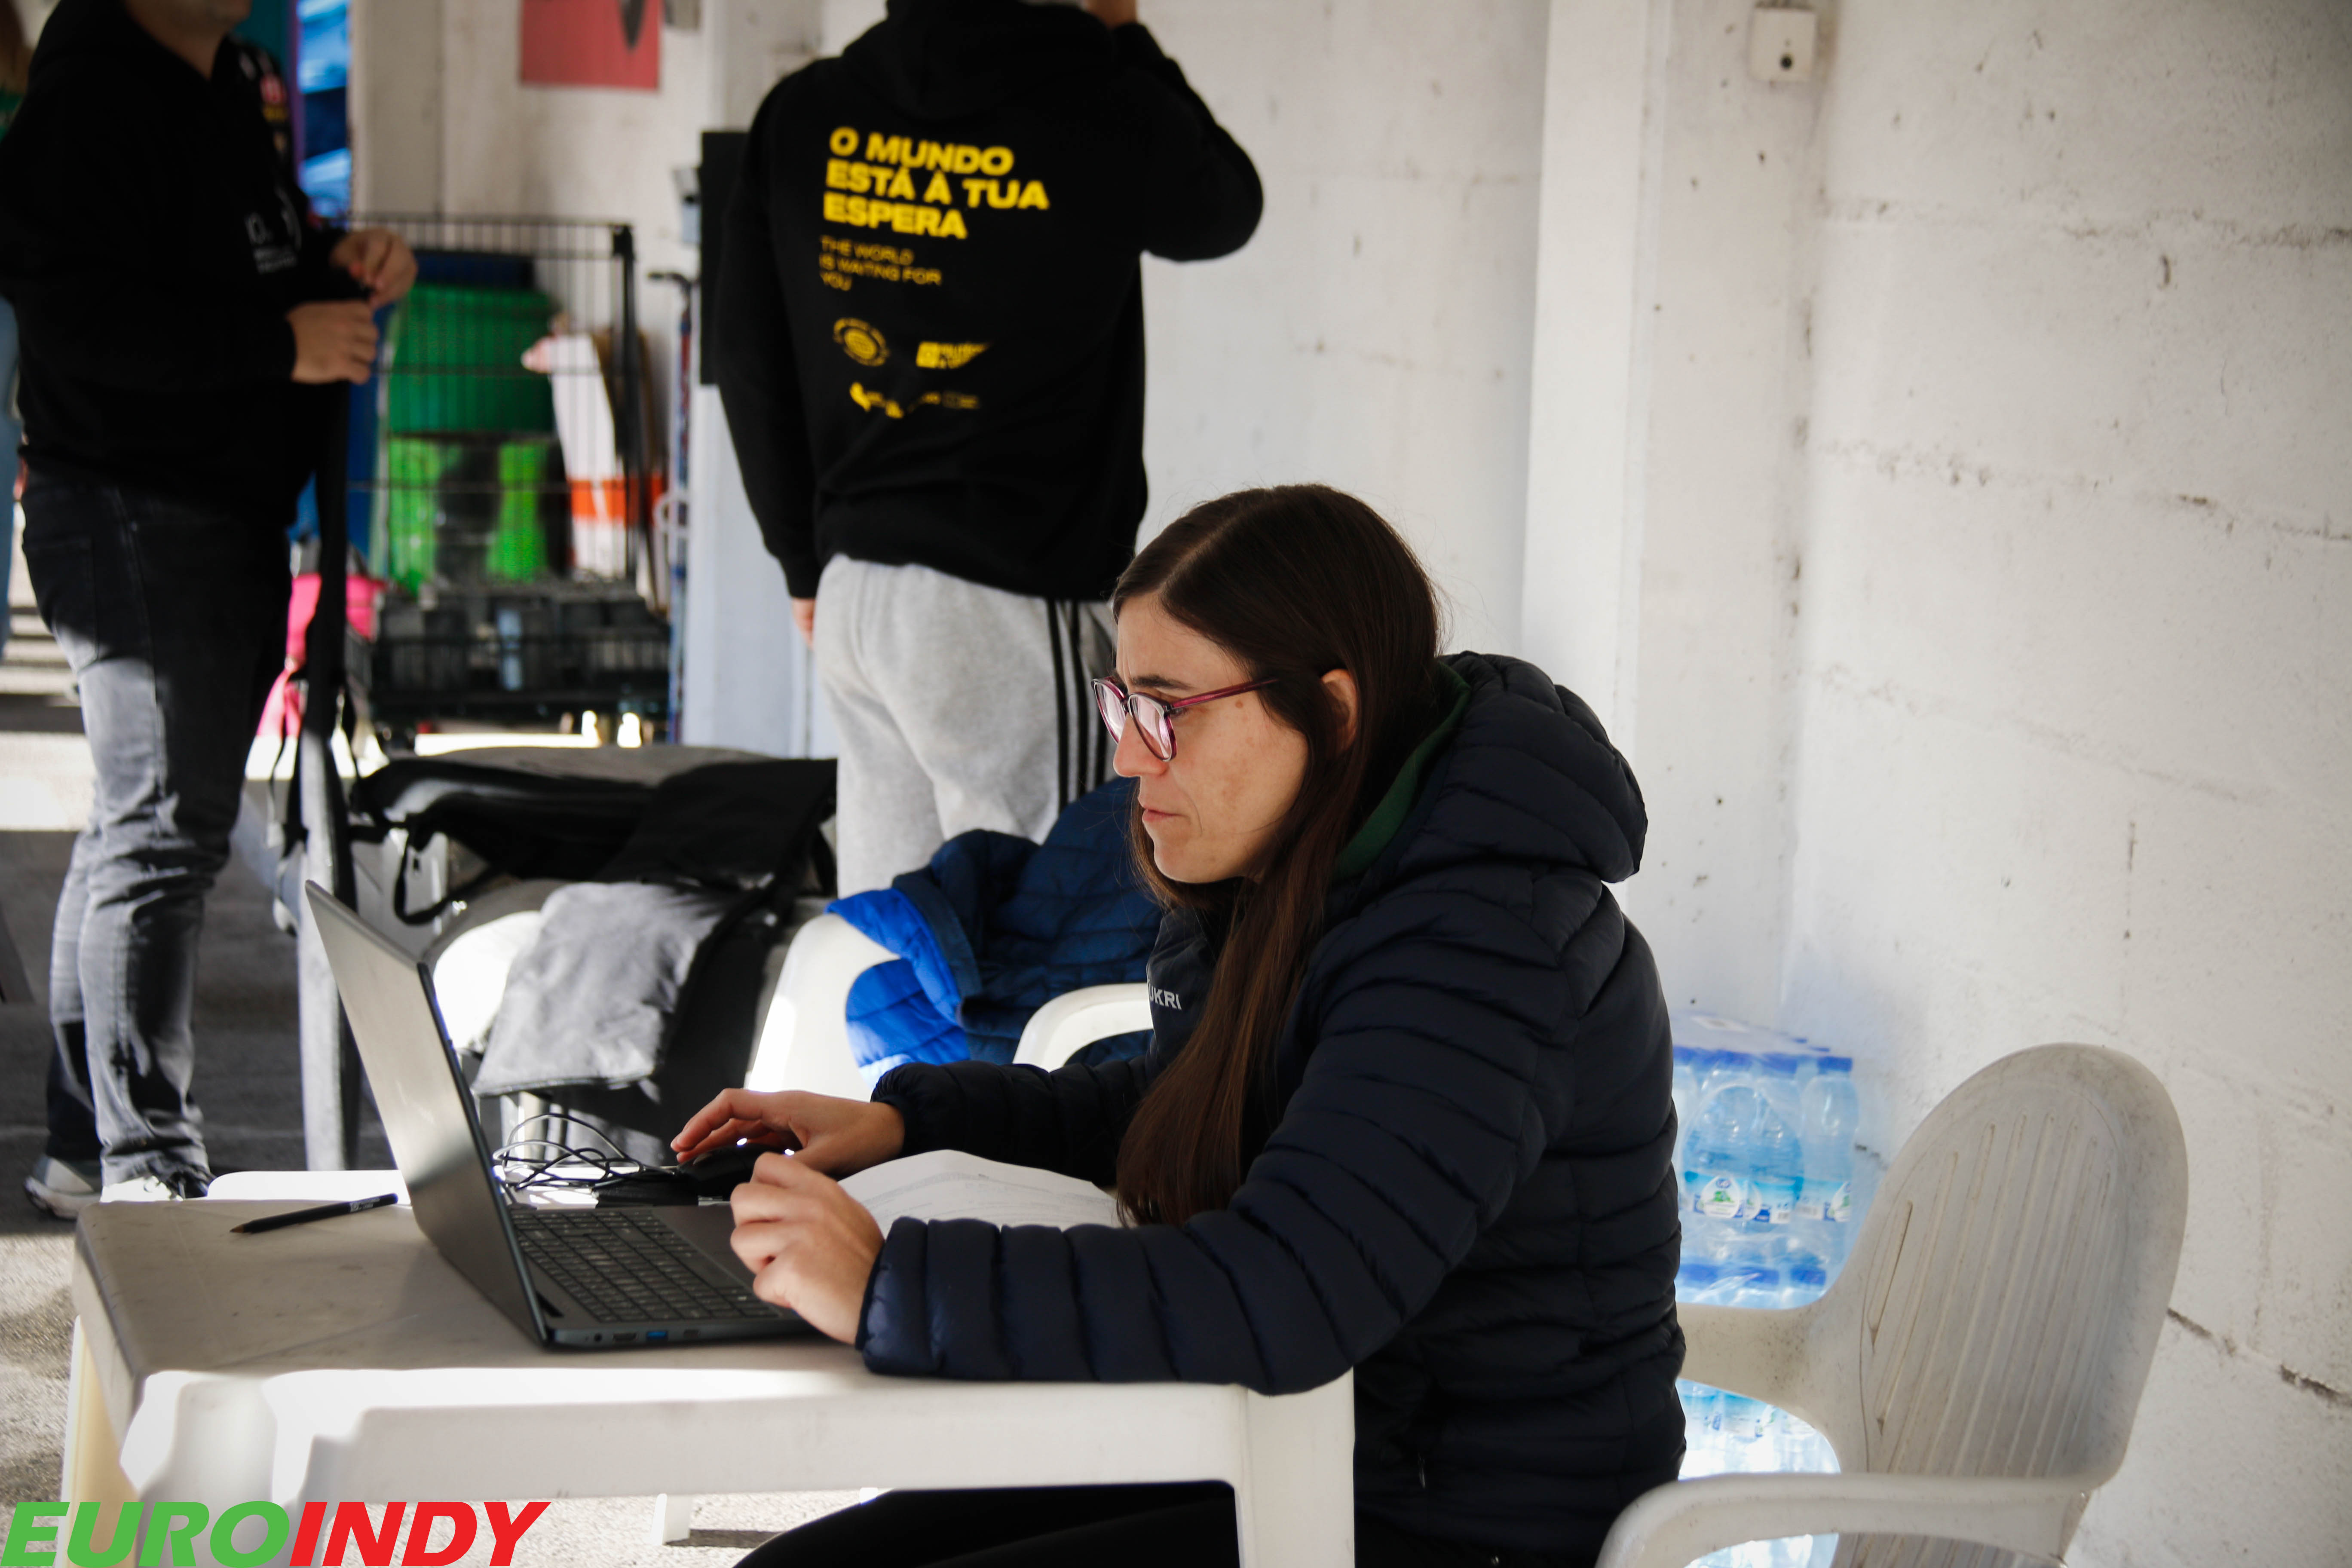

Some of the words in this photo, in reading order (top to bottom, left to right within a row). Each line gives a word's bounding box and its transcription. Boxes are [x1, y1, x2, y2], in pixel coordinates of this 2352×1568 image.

[830, 127, 859, 156] O
[865, 132, 1014, 176] MUNDO
[962, 178, 1050, 210] TUA
[823, 191, 968, 240] ESPERA
[820, 235, 852, 257] THE
[853, 243, 914, 266] WORLD
[819, 270, 852, 292] YOU
[836, 257, 901, 282] WAITING
[901, 266, 942, 286] FOR
